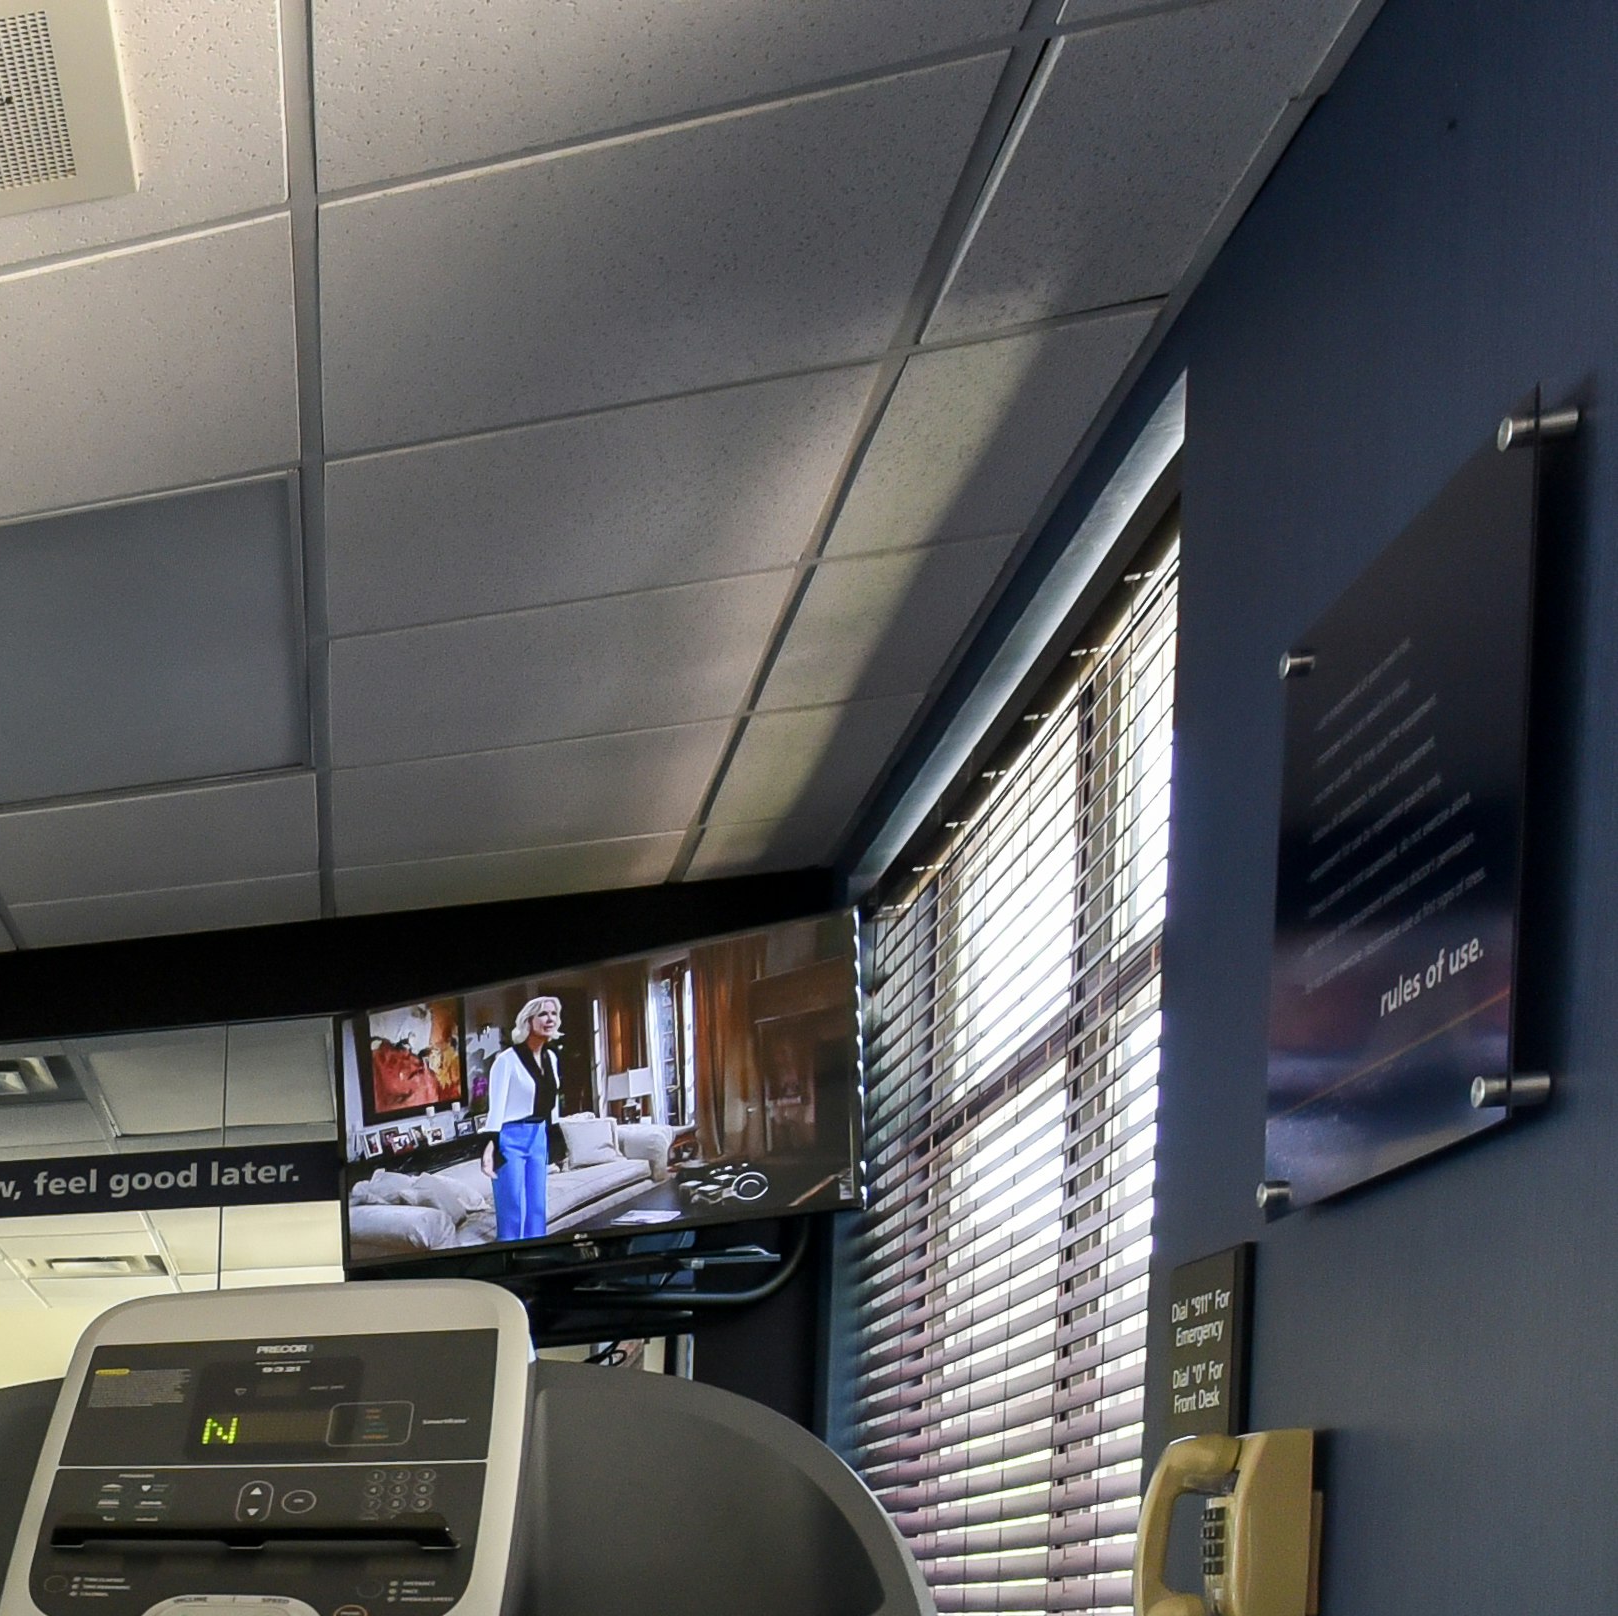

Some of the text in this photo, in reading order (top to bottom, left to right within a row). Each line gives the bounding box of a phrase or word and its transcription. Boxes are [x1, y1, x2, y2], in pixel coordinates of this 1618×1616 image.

[1380, 974, 1421, 1018] rules
[1425, 948, 1445, 989] of
[1449, 937, 1484, 976] use.
[34, 1168, 97, 1197] feel
[109, 1163, 199, 1198] good
[210, 1161, 300, 1187] later.
[1171, 1289, 1232, 1324] Dial "911" For
[1175, 1319, 1225, 1348] Emergency
[1172, 1365, 1190, 1390] Dial
[1208, 1360, 1224, 1380] For
[1173, 1385, 1220, 1414] Front Desk
[201, 1417, 239, 1445] N
